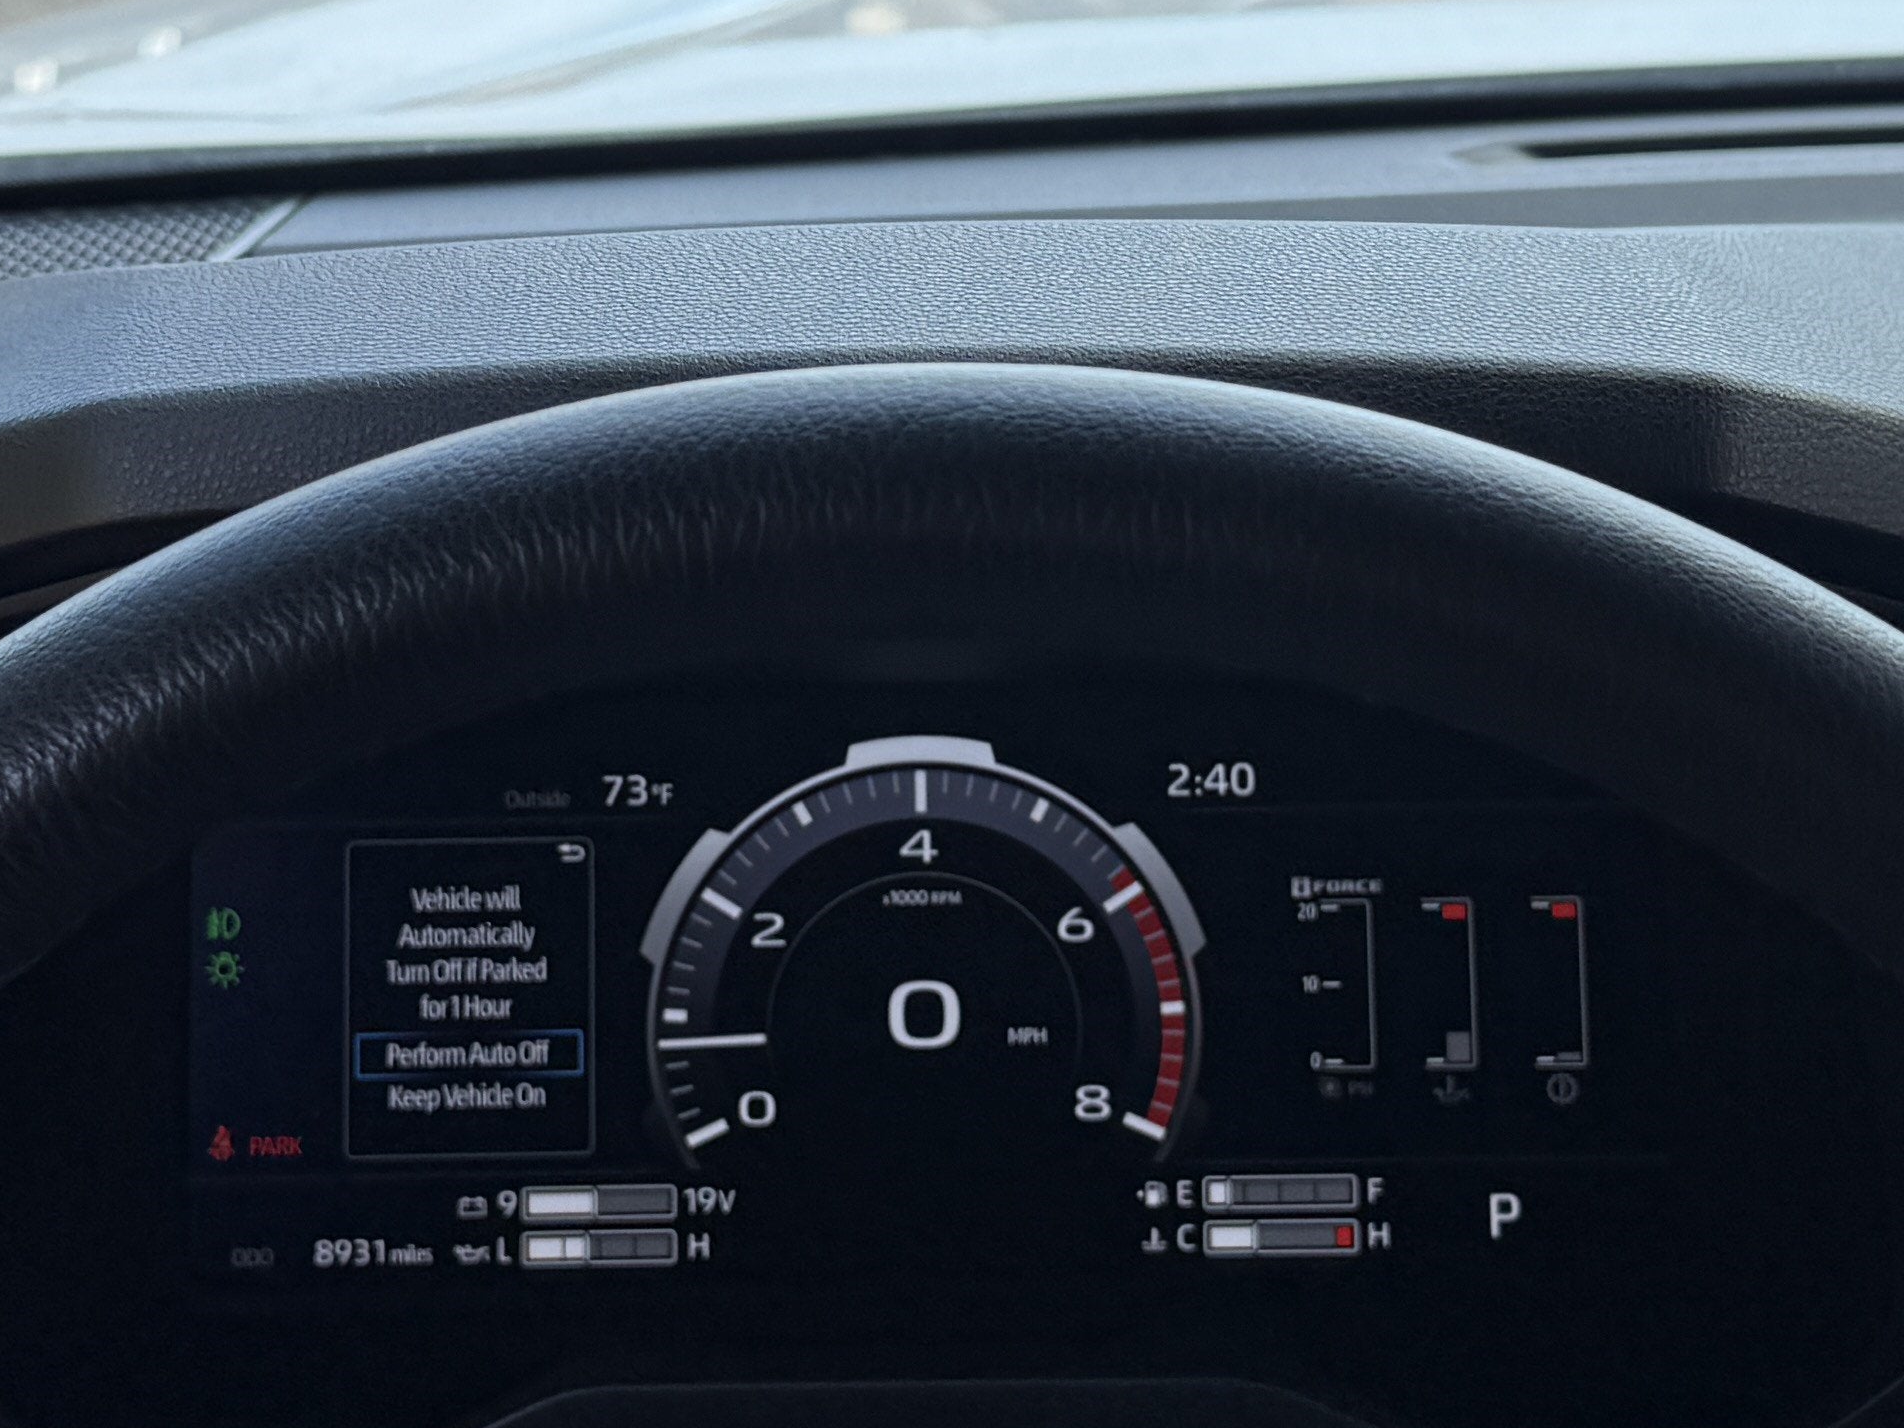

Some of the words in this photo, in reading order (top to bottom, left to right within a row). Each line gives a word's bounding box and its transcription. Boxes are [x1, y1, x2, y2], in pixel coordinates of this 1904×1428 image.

[1166, 762, 1257, 798] 2:40
[503, 790, 571, 809] Outside
[899, 829, 938, 863] 4
[409, 887, 483, 913] Vehicle
[484, 884, 522, 912] will
[930, 890, 963, 905] RPM
[1297, 902, 1319, 921] 20
[396, 922, 536, 951] Automatically
[751, 912, 787, 948] 2
[1056, 907, 1095, 943] 6
[385, 959, 430, 985] Turn
[431, 958, 462, 984] Off
[481, 956, 548, 983] Parked
[1302, 974, 1321, 994] 10
[418, 993, 449, 1020] for
[463, 994, 514, 1020] Hour
[888, 981, 961, 1050] 0
[1007, 1027, 1049, 1045] MPH
[384, 1042, 466, 1069] Perform
[467, 1041, 517, 1066] Auto
[518, 1038, 550, 1064] Off
[1309, 1050, 1323, 1071] 0
[386, 1085, 441, 1113] Keep
[442, 1083, 515, 1109] Vehicle
[516, 1082, 547, 1107] On
[737, 1090, 777, 1127] 0
[1074, 1085, 1112, 1122] 8
[249, 1135, 303, 1157] PARK
[496, 1190, 518, 1218] 9
[682, 1187, 736, 1216] 19V
[1176, 1179, 1195, 1209] E
[1368, 1179, 1384, 1205] F
[1489, 1192, 1523, 1241] P
[687, 1232, 711, 1260] H
[1176, 1224, 1197, 1253] C
[1367, 1221, 1392, 1248] H
[312, 1238, 387, 1268] 8931
[388, 1247, 435, 1265] miles
[497, 1237, 513, 1265] L
